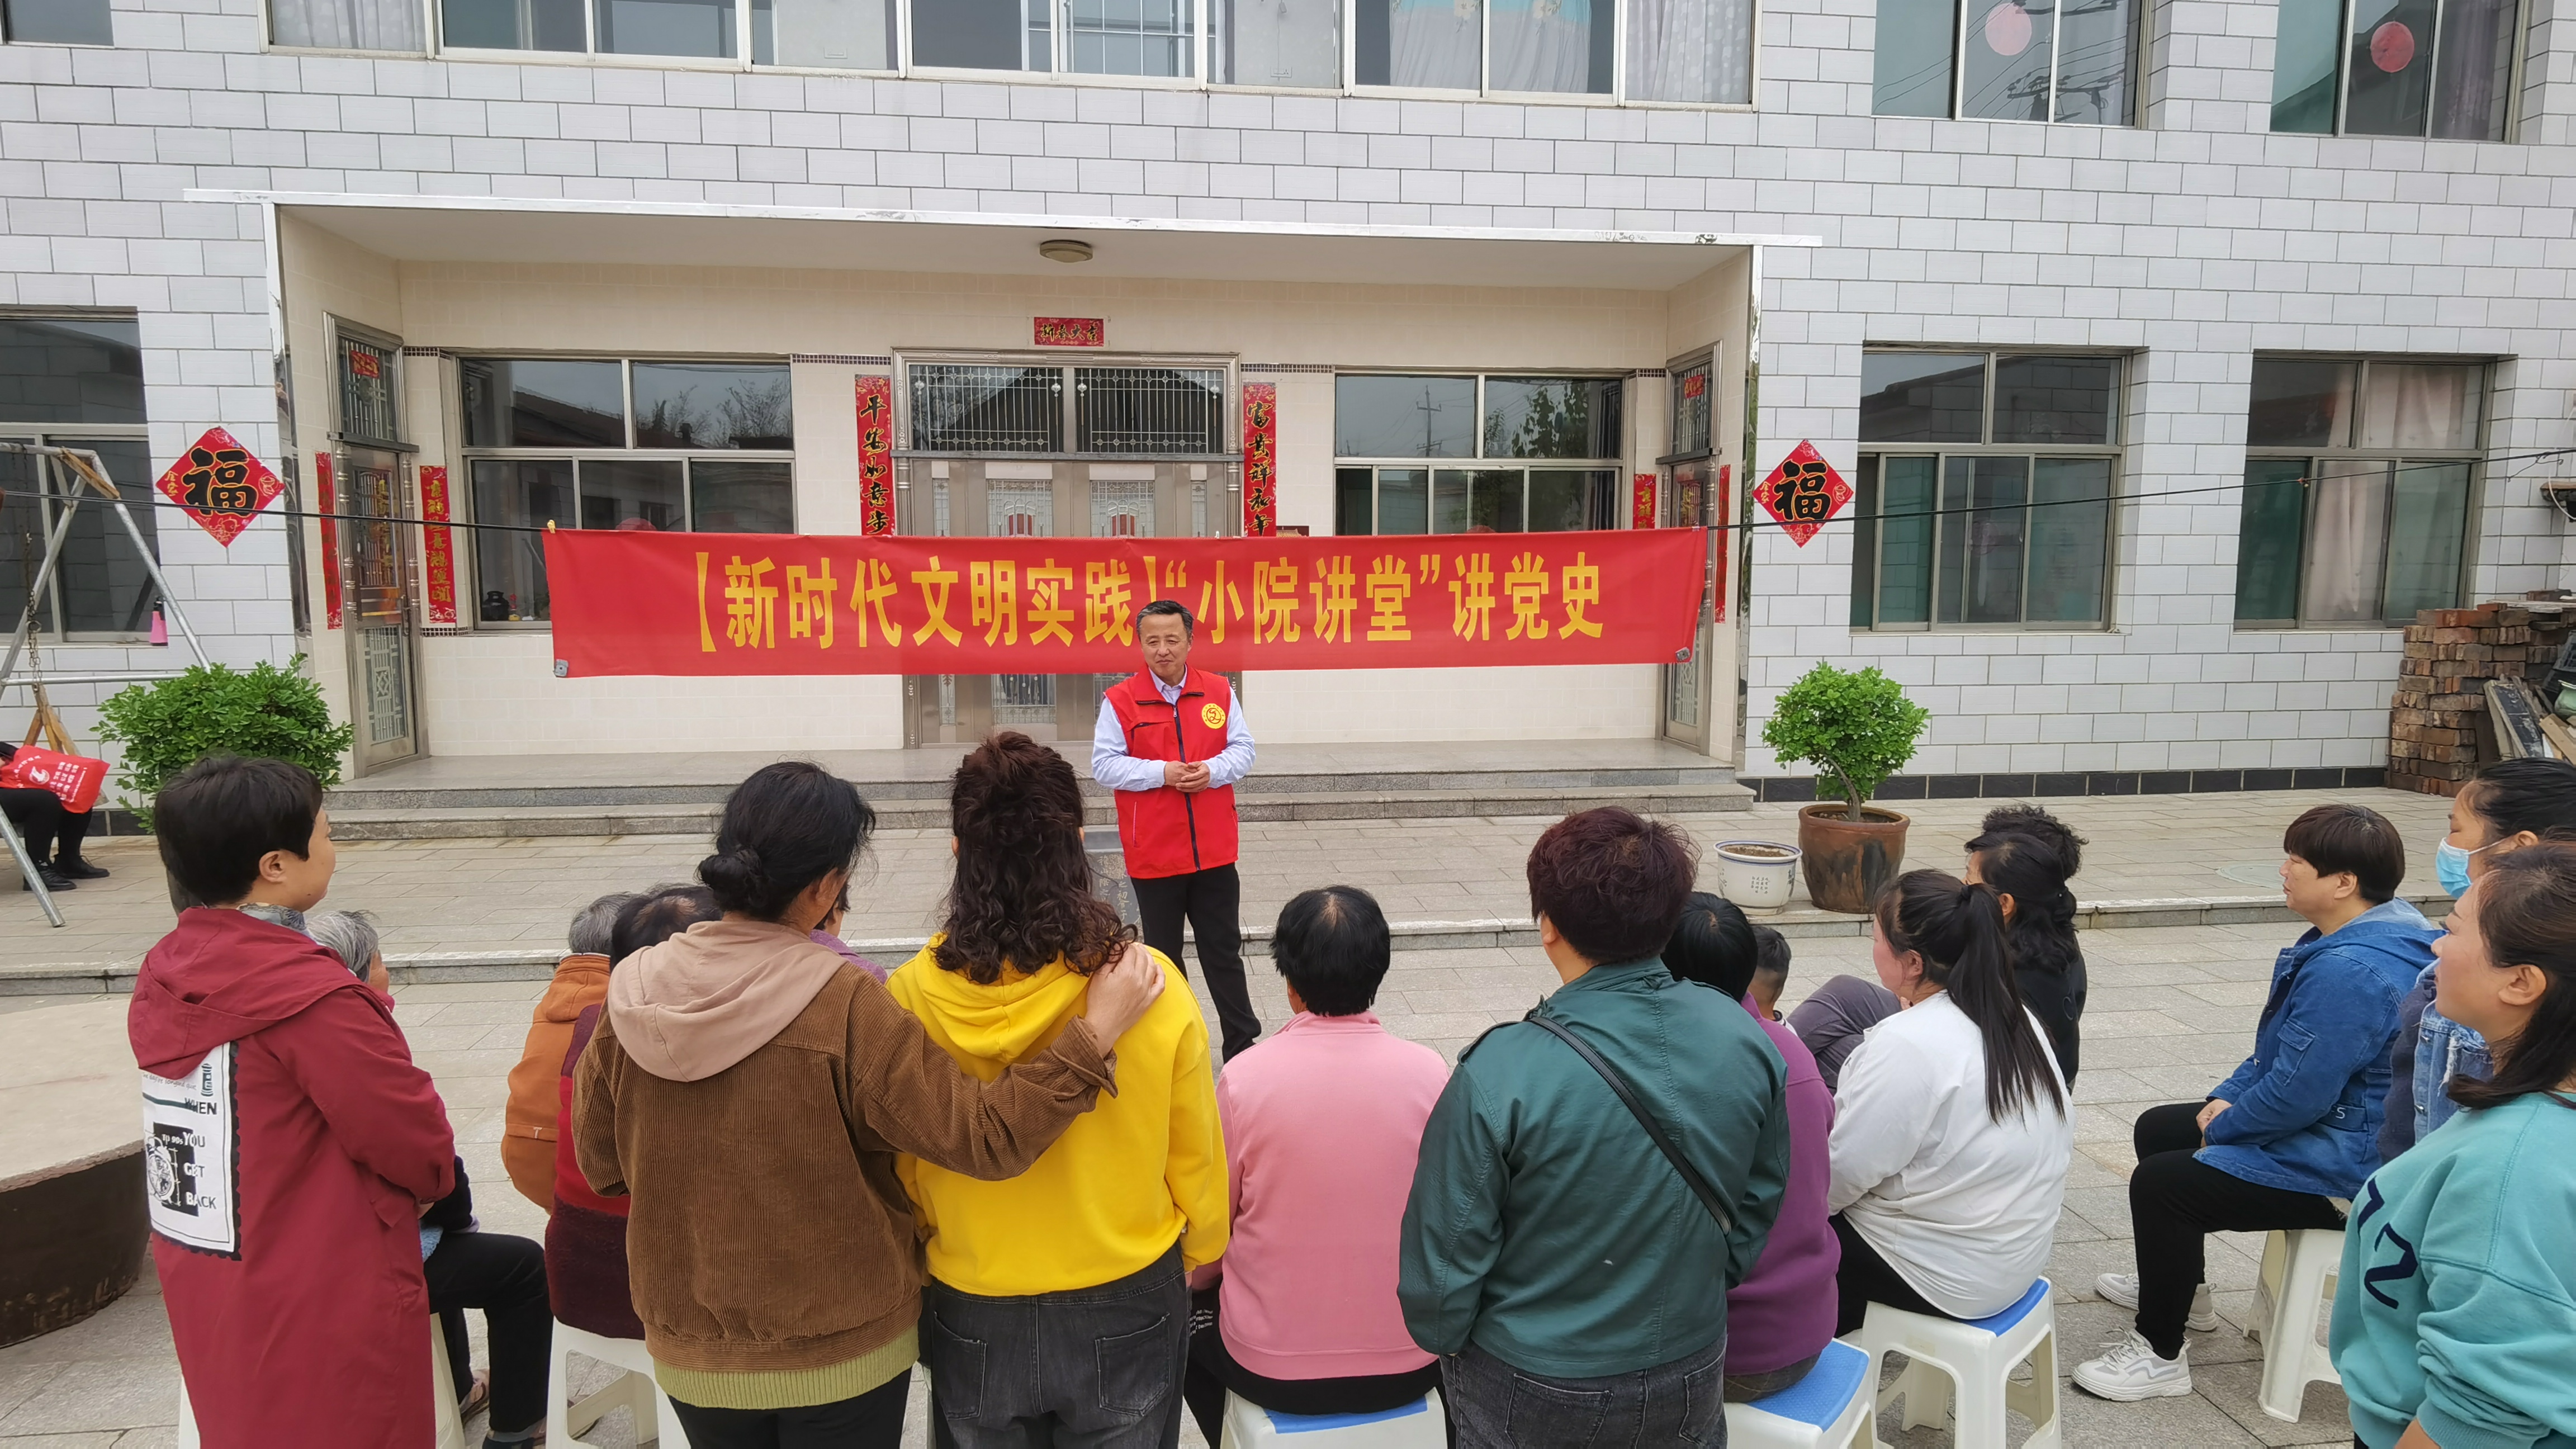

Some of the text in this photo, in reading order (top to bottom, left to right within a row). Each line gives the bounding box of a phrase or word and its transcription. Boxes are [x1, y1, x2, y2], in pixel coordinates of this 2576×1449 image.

[1040, 323, 1098, 342] 新春大吉
[181, 446, 259, 518] 福
[1773, 459, 1831, 521] 福
[184, 1097, 217, 1115] WHEN
[183, 1131, 206, 1148] YOU
[183, 1162, 205, 1178] GET
[186, 1191, 217, 1209] BACK
